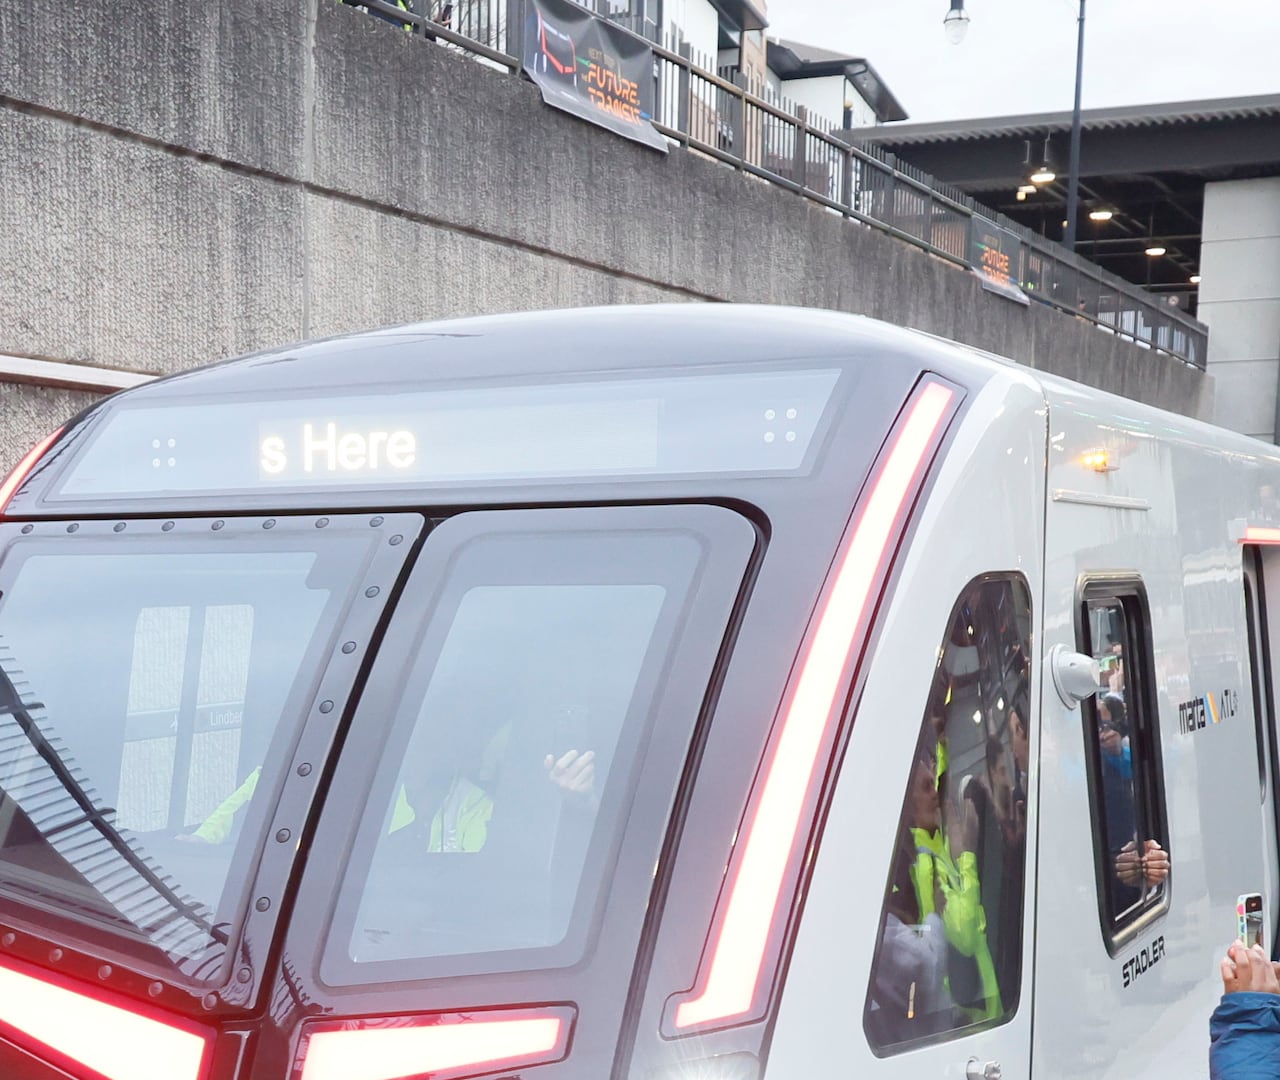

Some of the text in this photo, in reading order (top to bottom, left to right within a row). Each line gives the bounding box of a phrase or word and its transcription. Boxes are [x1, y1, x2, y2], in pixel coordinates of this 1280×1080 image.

[587, 62, 639, 105] FUTURE
[260, 422, 417, 473] s Here
[1179, 696, 1206, 735] marta
[1123, 936, 1166, 988] STADLER
